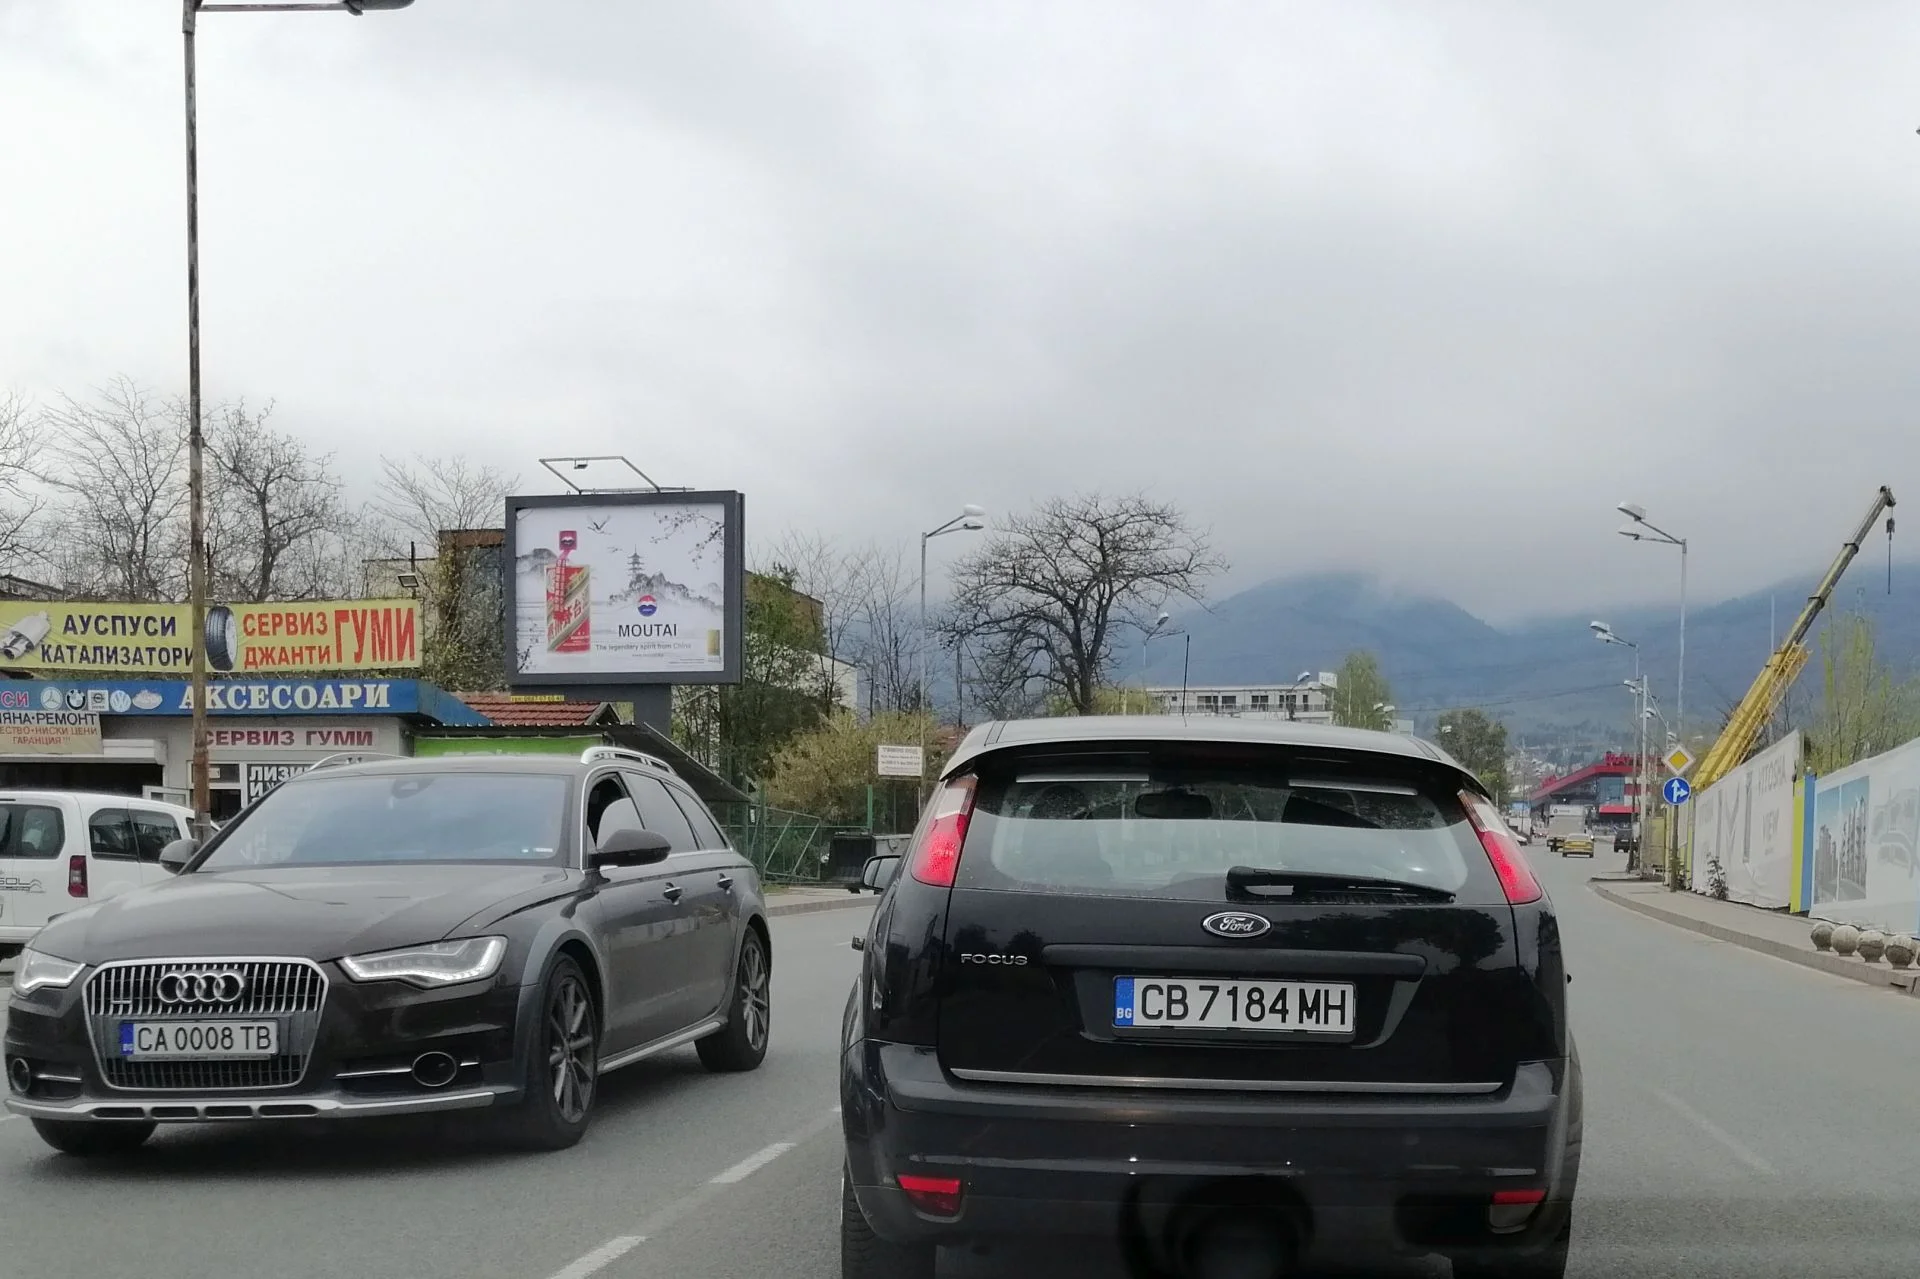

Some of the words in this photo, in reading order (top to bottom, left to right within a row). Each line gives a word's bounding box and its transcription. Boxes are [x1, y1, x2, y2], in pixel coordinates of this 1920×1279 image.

[62, 614, 177, 637] АУСПУСИ
[242, 611, 328, 637] СЕРВИЗ
[334, 607, 415, 664] ГУМИ
[618, 623, 677, 637] MOUTAI
[40, 644, 193, 667] КАТАЛИЗАТОРИ
[244, 645, 331, 669] ДЖАНТИ
[178, 683, 391, 710] АКСЕСОАРИ
[71, 726, 97, 736] ЦЕНИ
[206, 729, 295, 746] СЕРВИЗ
[306, 730, 373, 746] ГУМИ
[1219, 916, 1255, 932] Ford
[960, 953, 1029, 966] FOCUS
[1116, 1007, 1132, 1019] BG
[1141, 984, 1189, 1021] CB
[1198, 985, 1289, 1024] 7184
[1299, 987, 1347, 1026] MH
[137, 1027, 168, 1051] CA
[174, 1026, 234, 1051] 0008
[239, 1025, 272, 1050] TB
